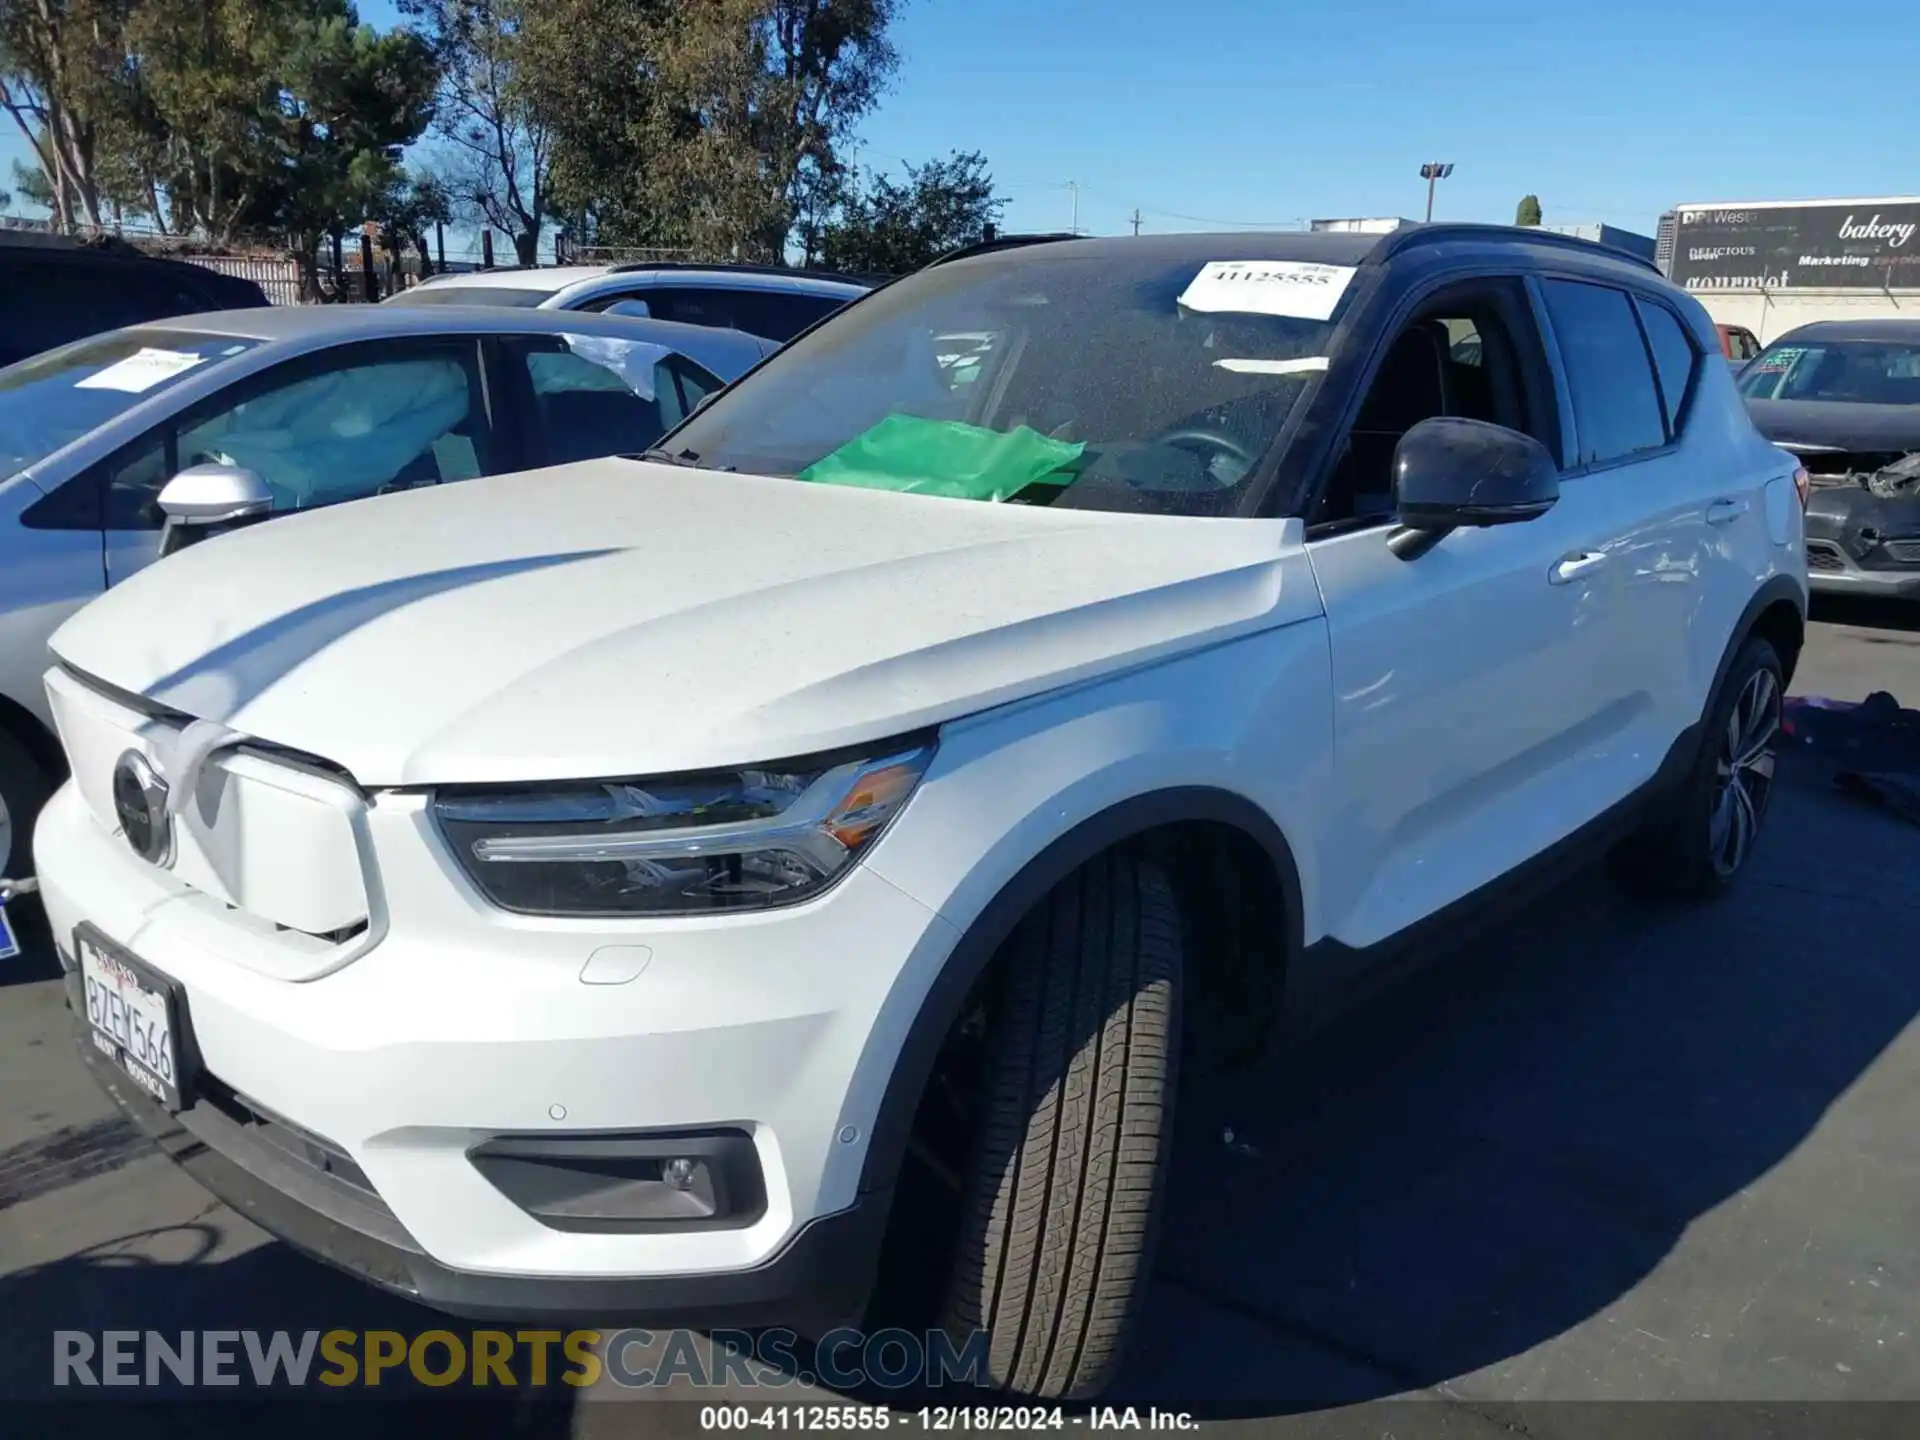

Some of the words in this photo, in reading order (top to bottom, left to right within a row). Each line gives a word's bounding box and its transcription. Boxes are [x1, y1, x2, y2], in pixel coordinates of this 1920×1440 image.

[1839, 214, 1916, 248] bakery
[1798, 255, 1870, 267] Marketing
[1212, 271, 1330, 286] 41125555
[88, 975, 171, 1081] 8ZEY566
